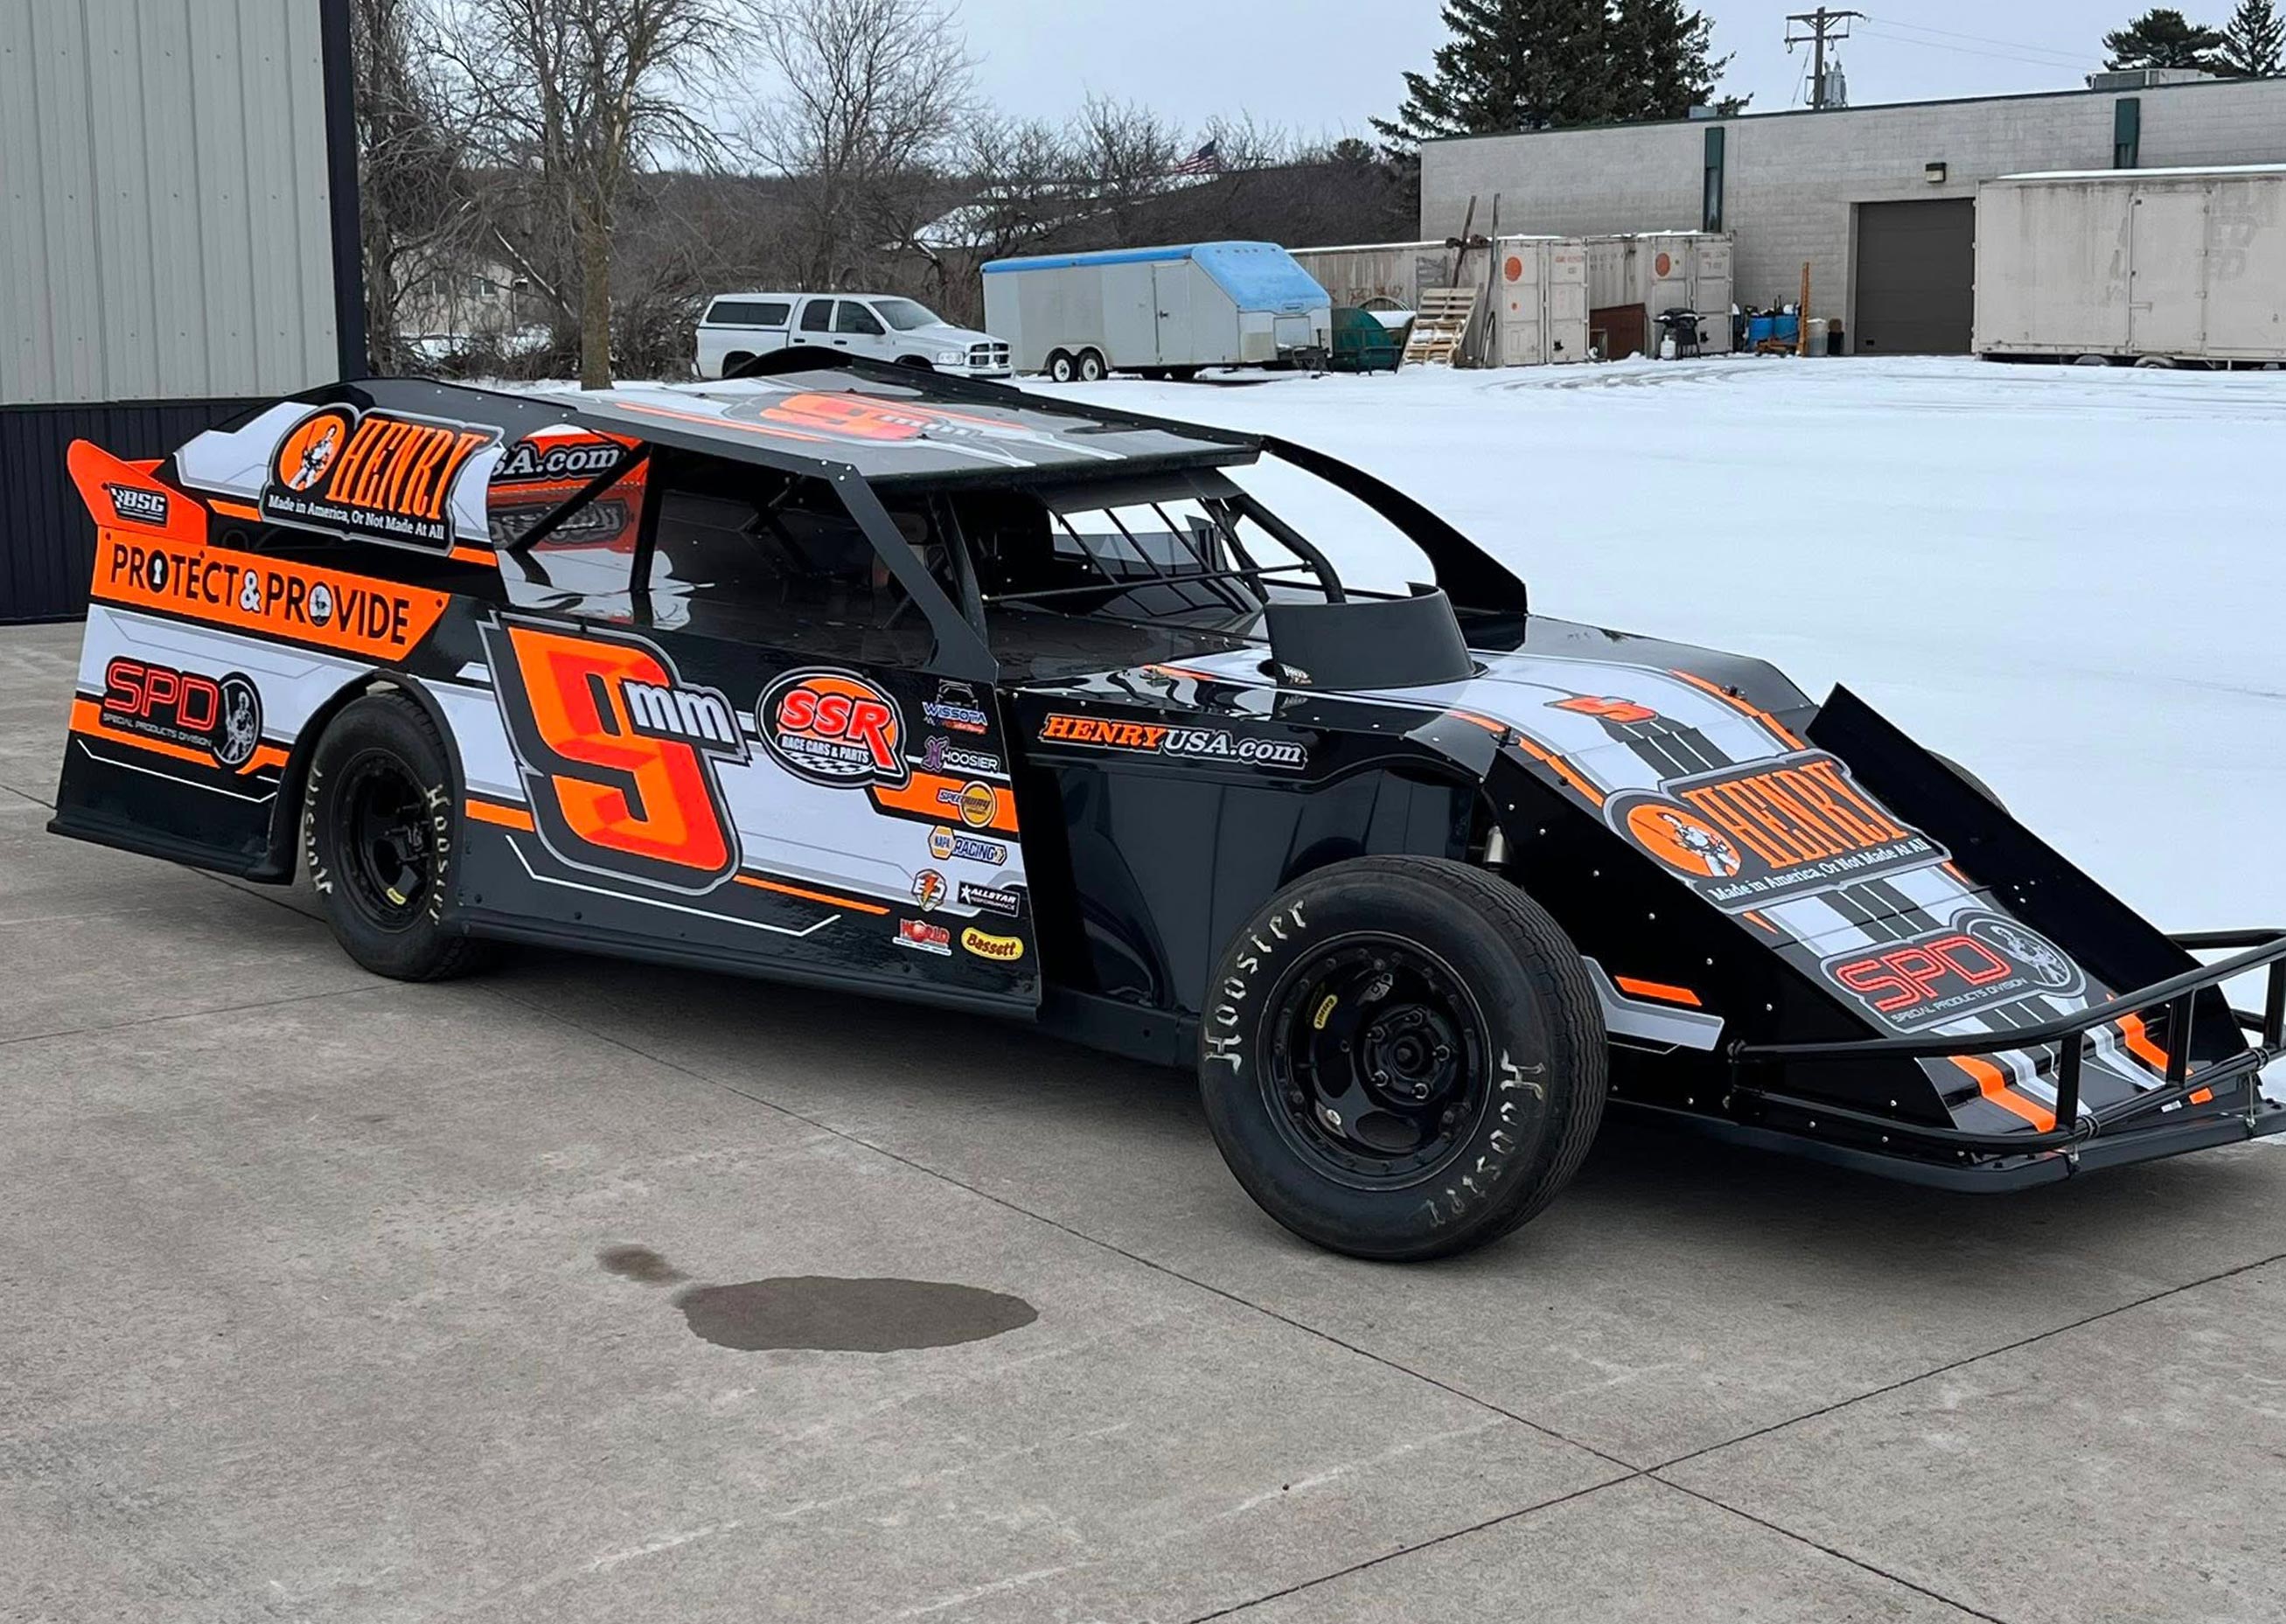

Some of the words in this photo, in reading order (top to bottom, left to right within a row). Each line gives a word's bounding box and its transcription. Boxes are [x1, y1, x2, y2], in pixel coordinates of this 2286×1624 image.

[325, 417, 490, 519] HENRY
[123, 490, 165, 512] BSG
[268, 495, 295, 512] Made
[296, 498, 306, 513] in
[307, 502, 350, 525] America,
[352, 510, 364, 525] Or
[365, 512, 384, 528] Not
[386, 516, 413, 533] Made
[415, 522, 427, 536] At
[429, 525, 444, 540] All
[104, 662, 219, 731] SPD
[922, 701, 988, 727] WISSOTA
[103, 712, 134, 728] SPECIAL
[135, 720, 177, 739] PRODUCTS
[178, 731, 213, 747] DIVISION
[779, 689, 897, 770] SSR
[782, 735, 804, 751] RACE
[806, 740, 830, 756] CARS
[829, 747, 838, 757] &
[840, 746, 870, 763] PARTS
[1042, 714, 1302, 763] HENRYUSA.com
[941, 750, 997, 770] HOOSIER
[1682, 760, 1908, 869] HENRY
[954, 839, 995, 861] RACING
[1708, 883, 1750, 902] Made
[1750, 878, 1767, 893] in
[1764, 868, 1825, 889] America,
[1818, 862, 1839, 874] Or
[1836, 855, 1865, 871] Not
[1861, 848, 1897, 866] Made
[1894, 843, 1913, 856] At
[1912, 838, 1932, 852] All
[971, 888, 1016, 904] ALLSTAR
[966, 932, 1016, 957] Bassett
[1836, 935, 2011, 1012] SPD
[1891, 1007, 1935, 1023] SPECIAL
[1933, 988, 1988, 1011] PRODUCTS
[1984, 976, 2030, 994] DIVISION
